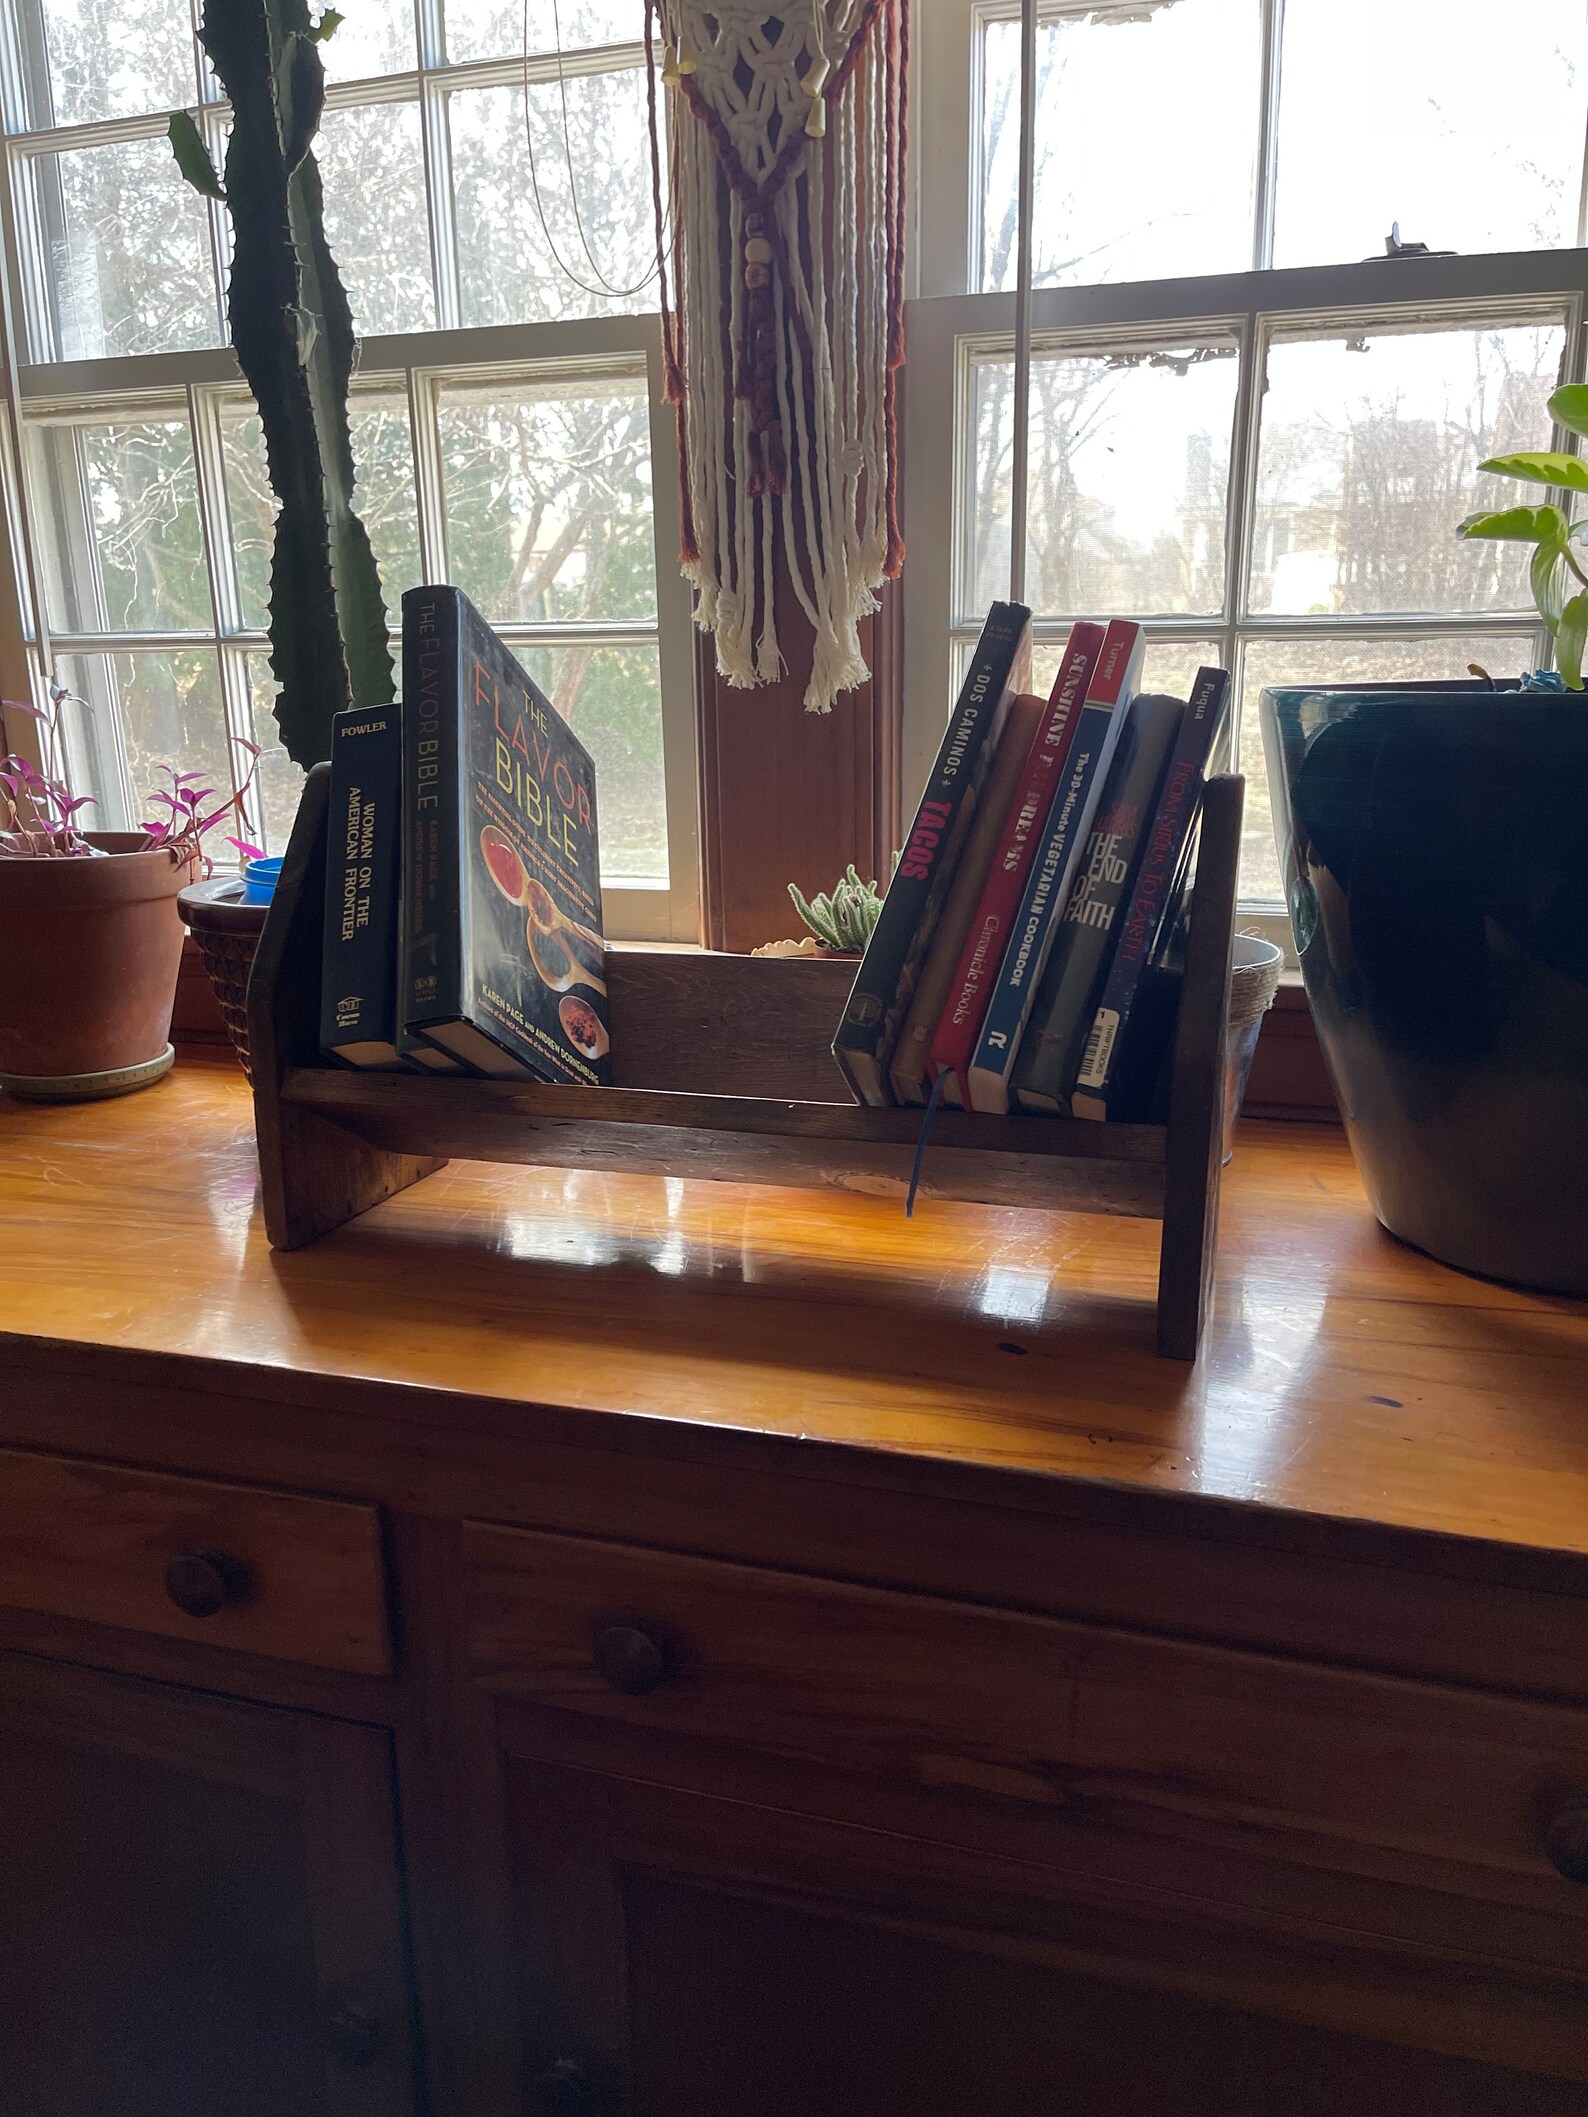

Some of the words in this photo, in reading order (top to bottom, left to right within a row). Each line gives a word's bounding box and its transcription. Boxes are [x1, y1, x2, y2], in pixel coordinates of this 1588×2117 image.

[419, 602, 436, 635] THE
[419, 638, 440, 735] FLAVOR
[969, 673, 991, 704] DOS
[1102, 642, 1124, 681] Turner
[341, 720, 387, 737] FOWLER
[523, 690, 549, 738] THE
[1044, 653, 1088, 748] SUNSHINE
[1195, 683, 1216, 720] Fuqua
[475, 660, 592, 835] FLAVOR
[943, 708, 979, 777] CAMINOS
[1077, 752, 1091, 772] The
[417, 739, 439, 811] BIBLE
[495, 737, 579, 867] BIBLE
[1057, 770, 1085, 833] 30-Minute
[1161, 761, 1195, 820] FROM
[346, 787, 362, 861] AMERICAN
[360, 802, 375, 859] WOMAN
[900, 800, 953, 881] TACOS
[1148, 818, 1178, 866] SIRIUS
[359, 866, 372, 889] ON
[1030, 834, 1066, 915] VEGETARIAN
[1141, 870, 1165, 896] TO
[341, 867, 358, 942] FRONTIER
[356, 895, 371, 928] THE
[1063, 899, 1116, 931] FAITH
[1119, 896, 1156, 962] EARTH
[967, 914, 1000, 981] Chronicle
[1009, 916, 1040, 987] COOKBOOK
[482, 983, 506, 1010] KAREN
[506, 1003, 524, 1026] PAGE
[952, 980, 979, 1025] Books
[1096, 1024, 1115, 1075] THRIFTBOOKS
